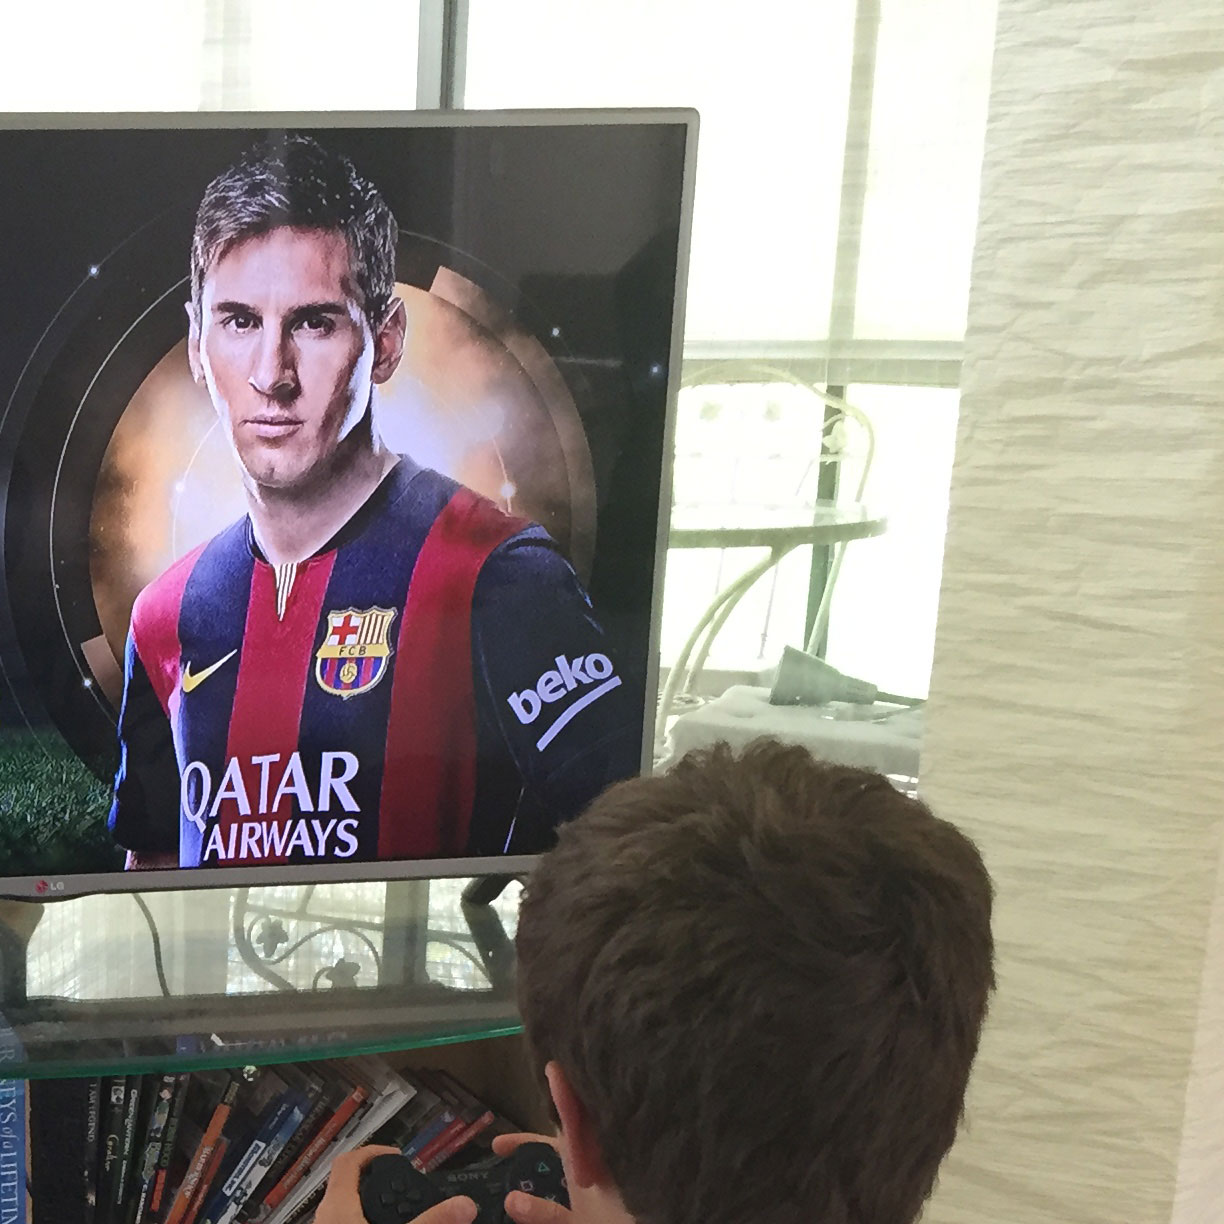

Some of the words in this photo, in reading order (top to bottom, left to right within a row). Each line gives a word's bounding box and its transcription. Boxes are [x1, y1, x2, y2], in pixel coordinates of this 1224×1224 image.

[507, 653, 614, 725] beko
[182, 751, 361, 833] QATAR
[204, 818, 361, 861] AIRWAYS
[50, 882, 65, 891] LG
